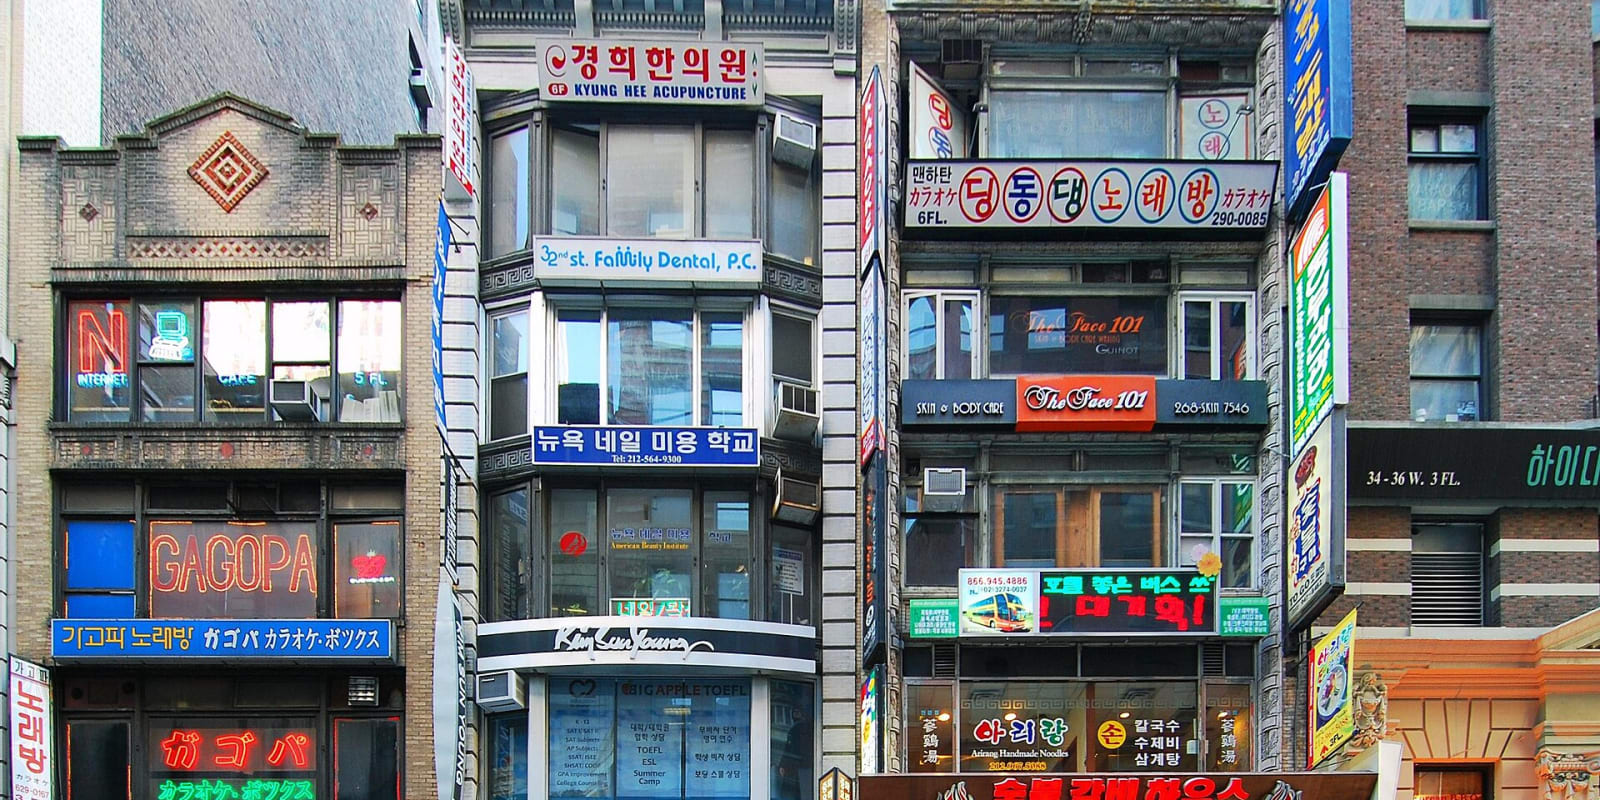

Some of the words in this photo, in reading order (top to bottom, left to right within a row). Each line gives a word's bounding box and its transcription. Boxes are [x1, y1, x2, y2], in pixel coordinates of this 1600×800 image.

[571, 45, 747, 83] 경희한의원
[551, 83, 567, 95] 6F
[574, 83, 617, 97] KYUNG
[624, 85, 647, 98] HEE
[653, 86, 747, 100] ACUPUNCTURE
[912, 165, 952, 184] 맨하탄
[909, 186, 957, 207] カラオケ
[1221, 188, 1271, 209] カラオケ
[917, 210, 948, 225] 6FL.
[1211, 211, 1267, 226] 290-0085
[570, 250, 589, 267] st.
[594, 245, 653, 273] Family
[658, 251, 721, 273] Dental,
[728, 252, 757, 270] P.C.
[1108, 315, 1145, 334] 101
[78, 309, 124, 374] N
[76, 372, 128, 388] INTERNET
[218, 373, 257, 386] CAFE
[354, 371, 364, 385] 5
[369, 372, 388, 386] FL.
[1024, 385, 1067, 410] The
[1066, 386, 1113, 410] Face
[1117, 390, 1149, 410] 101
[916, 401, 936, 416] SKIN
[953, 401, 983, 416] BODY
[983, 401, 1004, 416] CARE
[1174, 401, 1220, 415] 268-SKIN
[1224, 402, 1250, 415] 7546
[537, 430, 585, 453] 뉴욕
[594, 430, 641, 453] 네일
[651, 431, 698, 454] 미용
[707, 432, 755, 454] 학교
[611, 454, 625, 464] Tel:
[627, 454, 682, 464] 212-564-9300
[1408, 471, 1425, 486] W.
[1430, 471, 1438, 486] 3
[1440, 471, 1461, 486] FL.
[611, 542, 640, 550] American
[150, 533, 317, 594] GAGOPA
[967, 577, 1028, 585] 866.945.4886
[1140, 576, 1181, 594] 버스
[62, 626, 126, 650] 가고파
[131, 627, 194, 650] 노래방
[203, 628, 260, 650] ガゴパ
[456, 620, 466, 659] KIM
[14, 660, 49, 684] 가고파
[458, 662, 467, 707] SUN
[655, 684, 700, 696] APPLE
[705, 684, 746, 696] TOEFL
[17, 680, 47, 774] 노래방
[974, 718, 1069, 746] 아리랑
[1134, 719, 1181, 733] 칼국수
[650, 732, 666, 742] 상담
[1101, 724, 1124, 745] 손
[161, 730, 307, 770] ガゴパ
[455, 713, 467, 787] YOUNG
[637, 745, 664, 754] TOEFL
[1134, 736, 1180, 750] 수제비
[726, 753, 741, 762] 상담
[971, 749, 999, 759] Arirang
[999, 748, 1038, 758] Handmade
[1039, 748, 1069, 758] Noodles
[1134, 753, 1181, 767] 삼계탕
[642, 758, 657, 766] ESL
[633, 769, 667, 778] Summer
[638, 778, 661, 786] Camp
